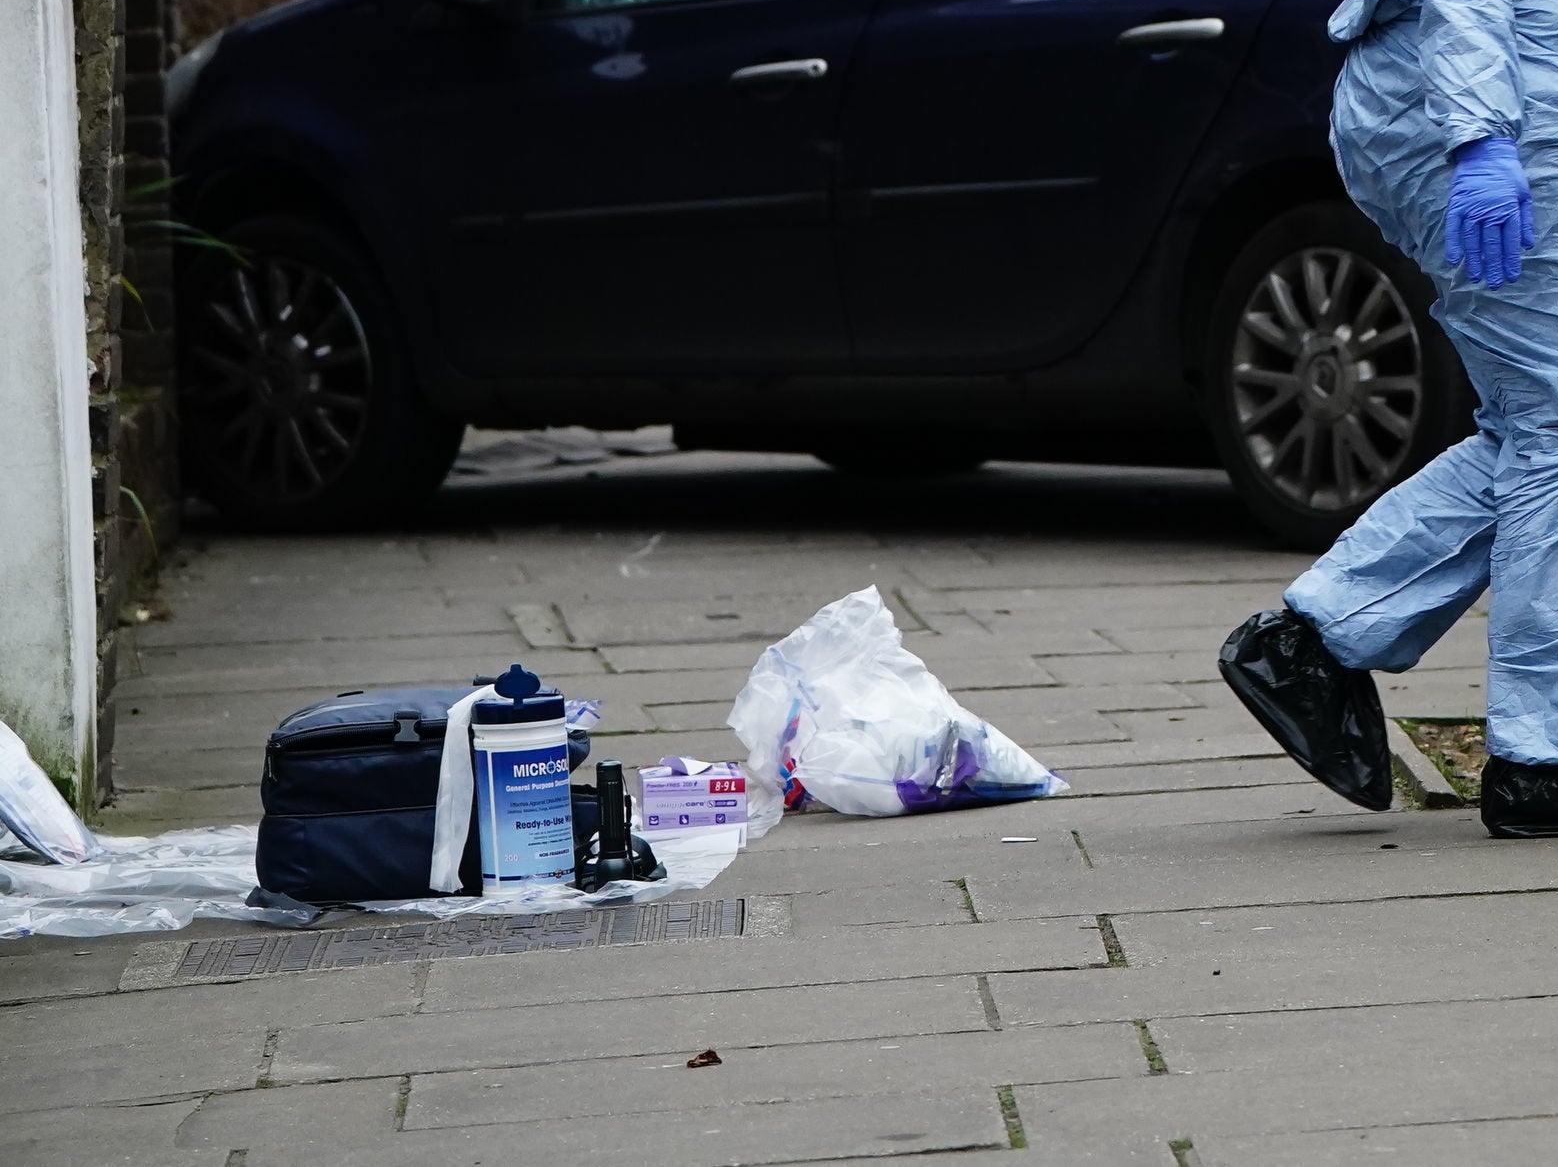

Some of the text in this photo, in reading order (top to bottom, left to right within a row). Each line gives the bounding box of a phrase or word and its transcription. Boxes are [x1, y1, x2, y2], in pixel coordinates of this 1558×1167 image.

[505, 784, 531, 792] General
[531, 781, 554, 790] Purpose
[515, 815, 564, 830] Ready-to-Use
